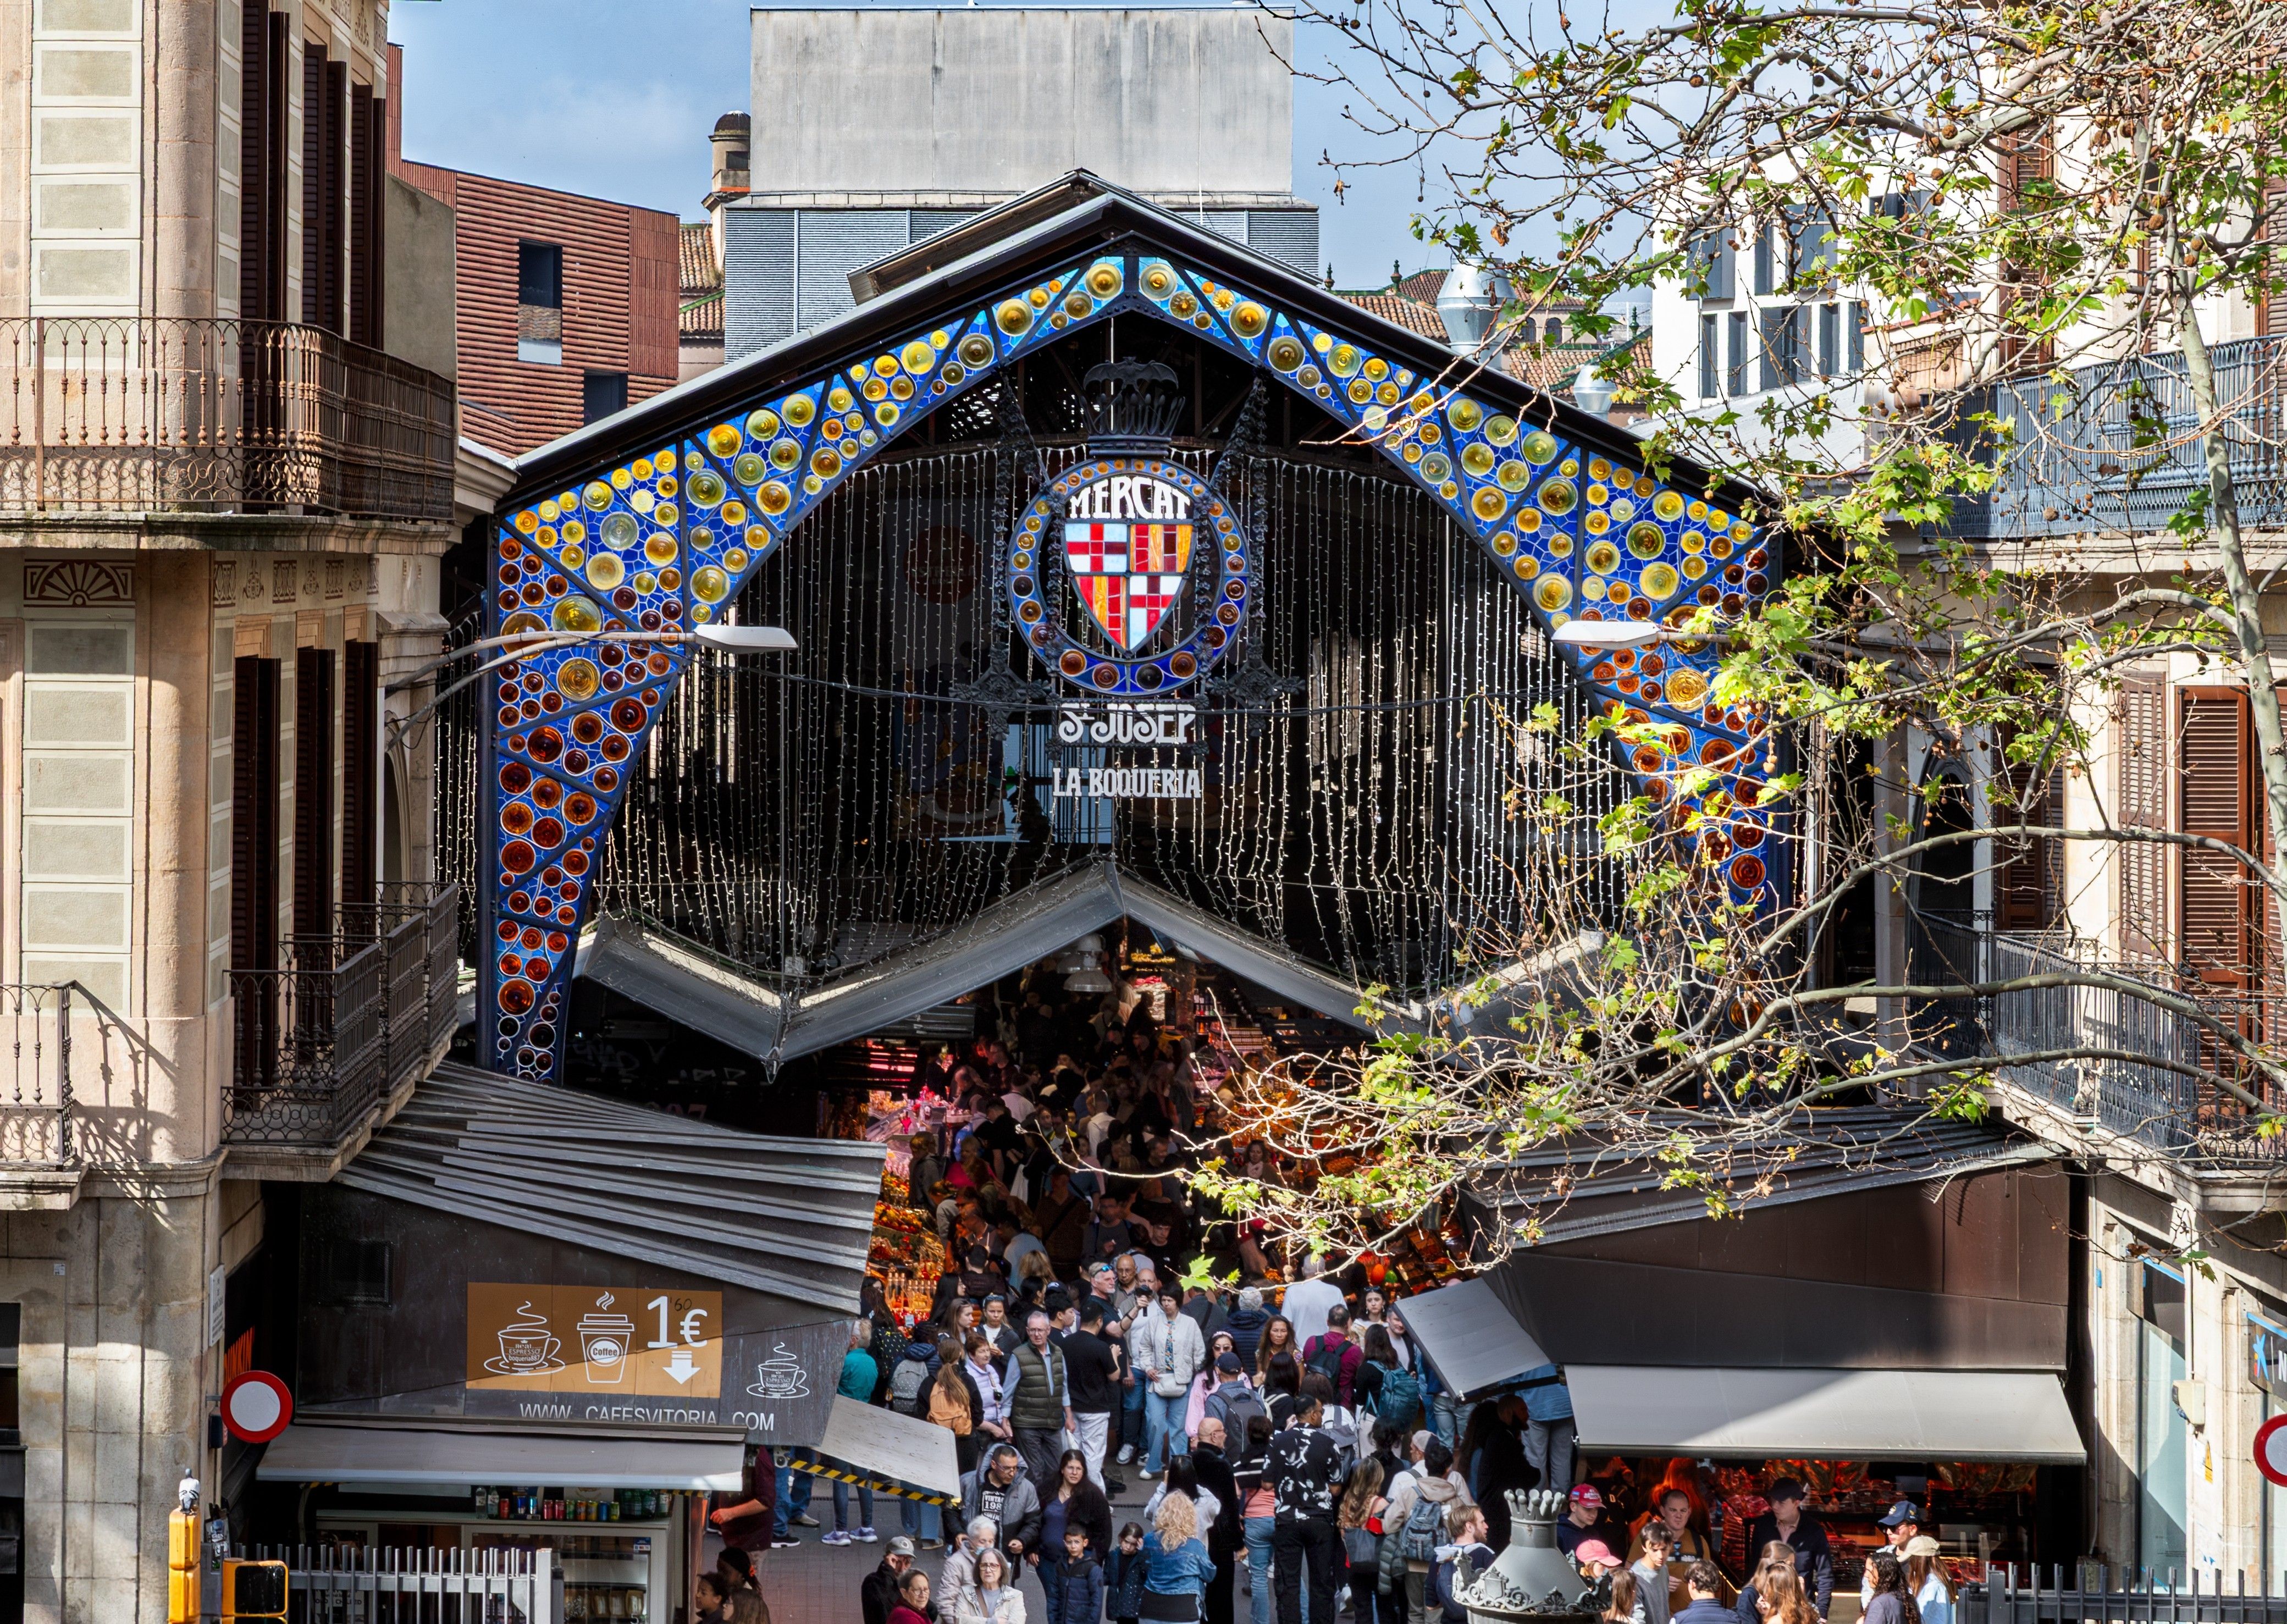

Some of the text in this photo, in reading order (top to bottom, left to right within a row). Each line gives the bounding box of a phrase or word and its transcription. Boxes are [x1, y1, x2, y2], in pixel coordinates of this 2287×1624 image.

[1069, 476, 1190, 520] MERCAT
[1090, 704, 1196, 744] JOSEP
[1053, 767, 1201, 798] LA BOQUERIA
[593, 1346, 617, 1356] Coffee
